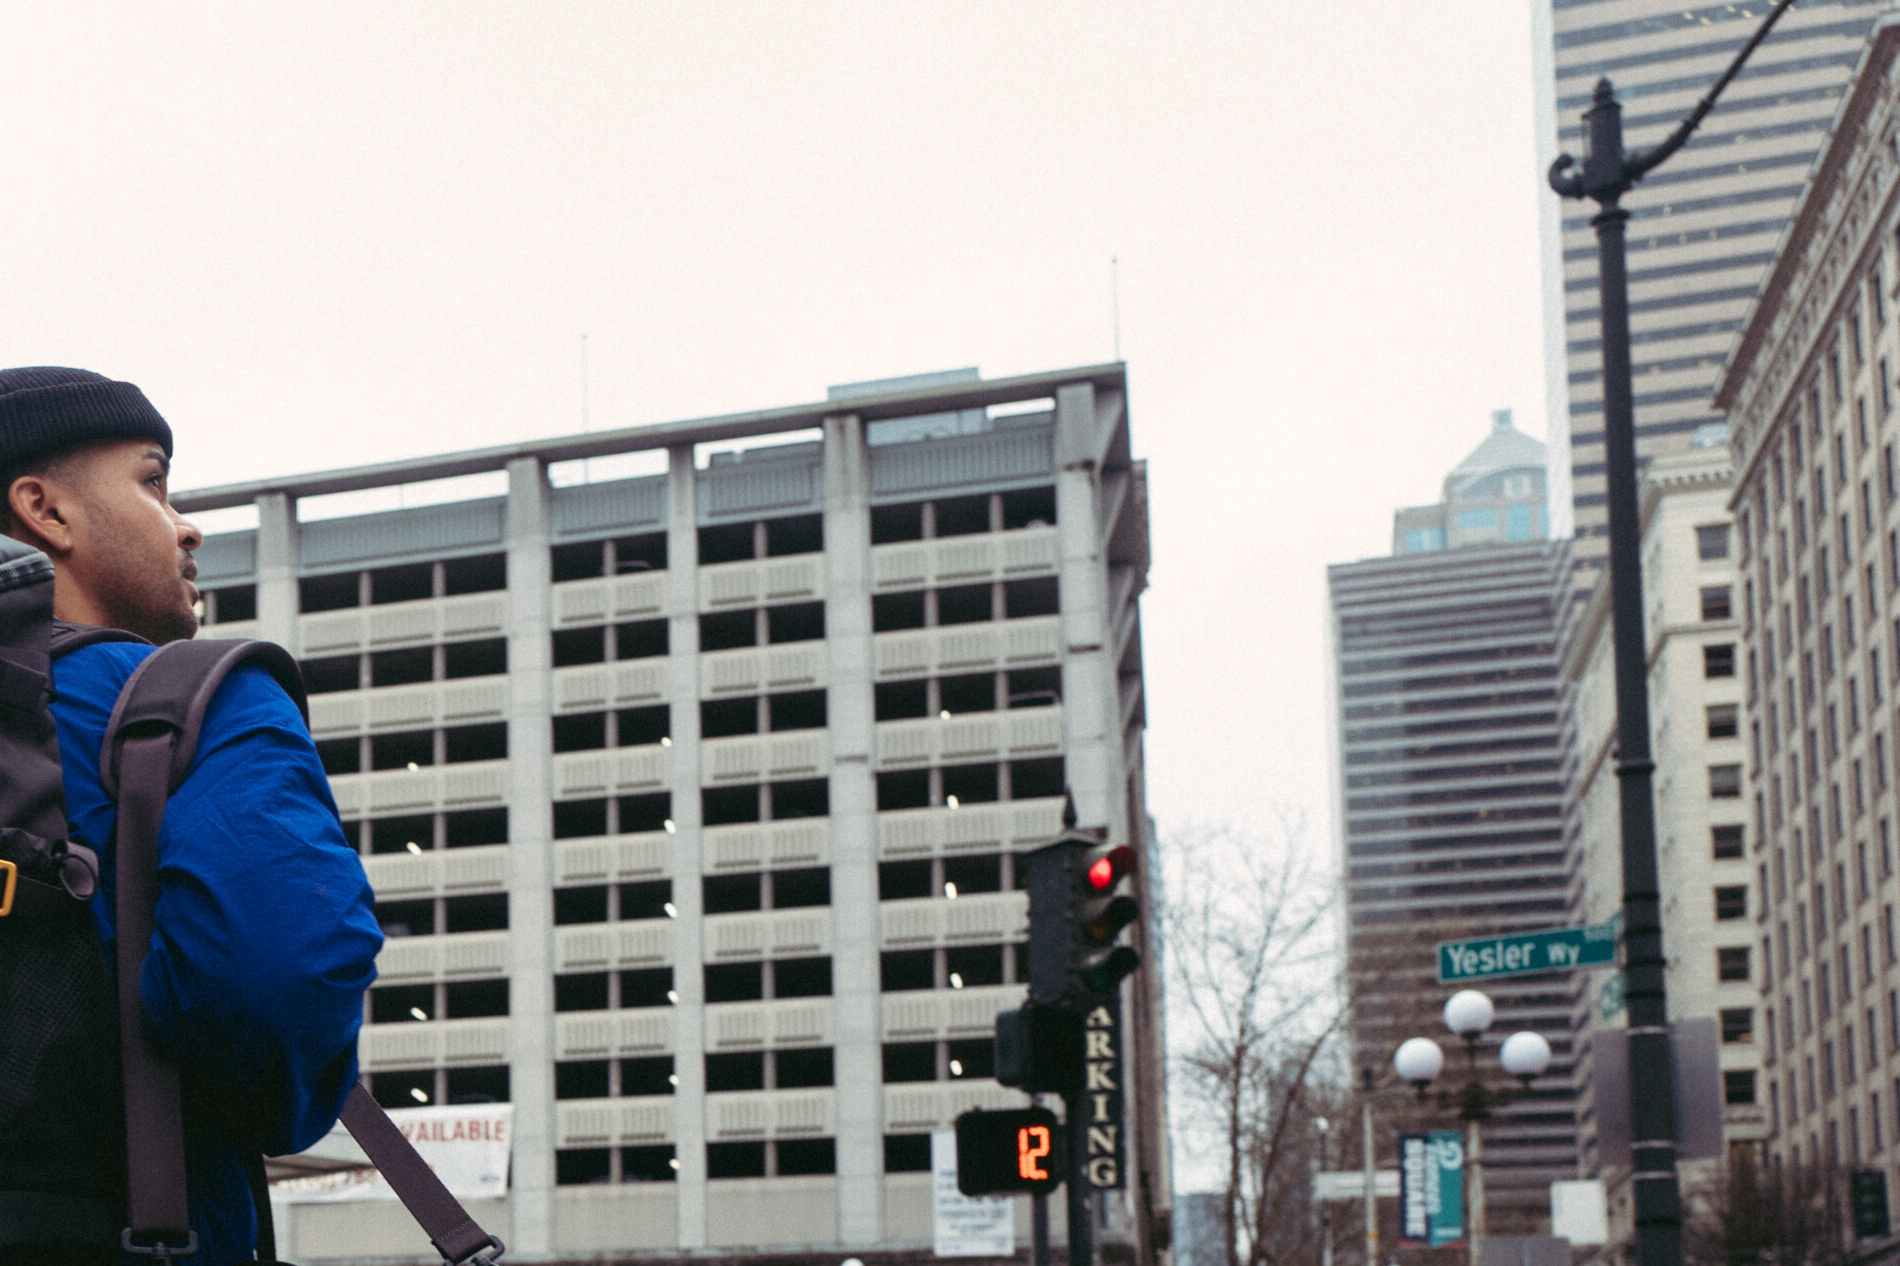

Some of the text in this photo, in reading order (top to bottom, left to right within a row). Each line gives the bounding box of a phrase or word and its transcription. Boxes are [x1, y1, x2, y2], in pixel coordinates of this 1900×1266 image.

[1447, 941, 1581, 975] Yesler Wy
[1018, 1126, 1050, 1180] 12
